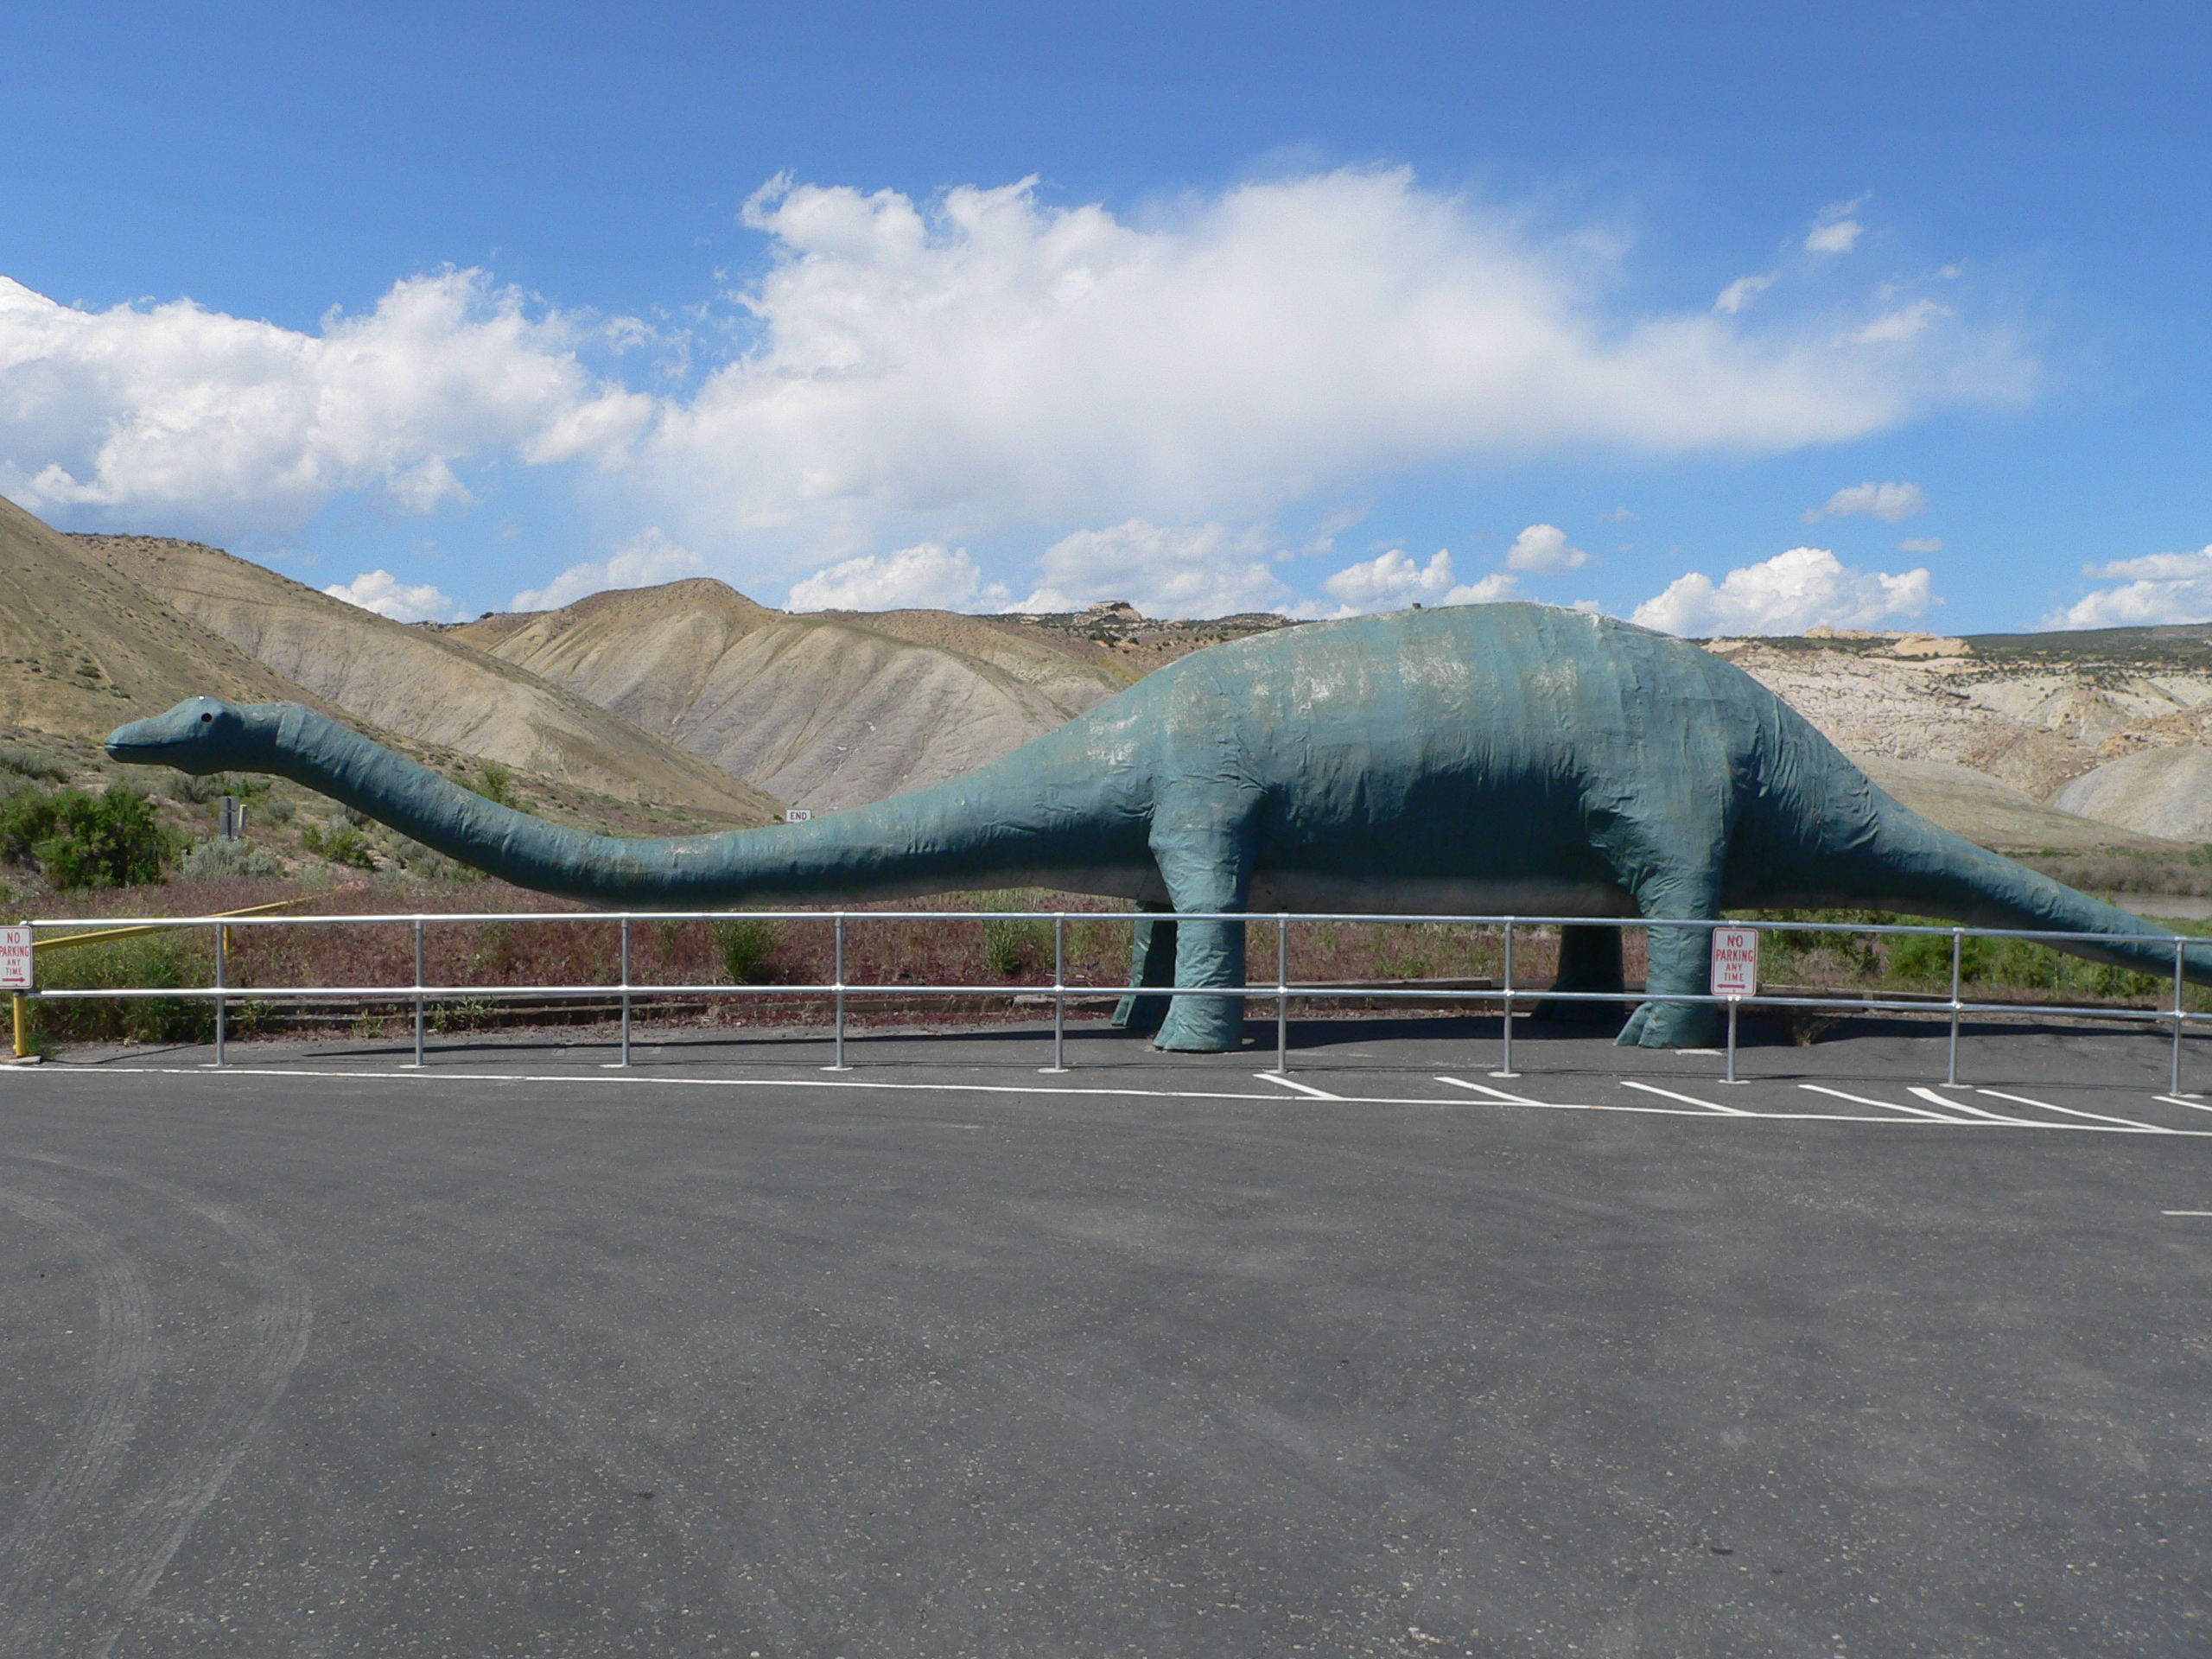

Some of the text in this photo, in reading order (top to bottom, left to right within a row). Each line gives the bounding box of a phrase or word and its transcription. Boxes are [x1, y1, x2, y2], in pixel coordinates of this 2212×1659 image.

[7, 932, 20, 944] NO
[1727, 935, 1743, 947] NO
[1716, 949, 1754, 962] PARKING
[6, 967, 22, 976] TIME
[1726, 963, 1743, 971] ANY
[1724, 973, 1744, 982] TIME
